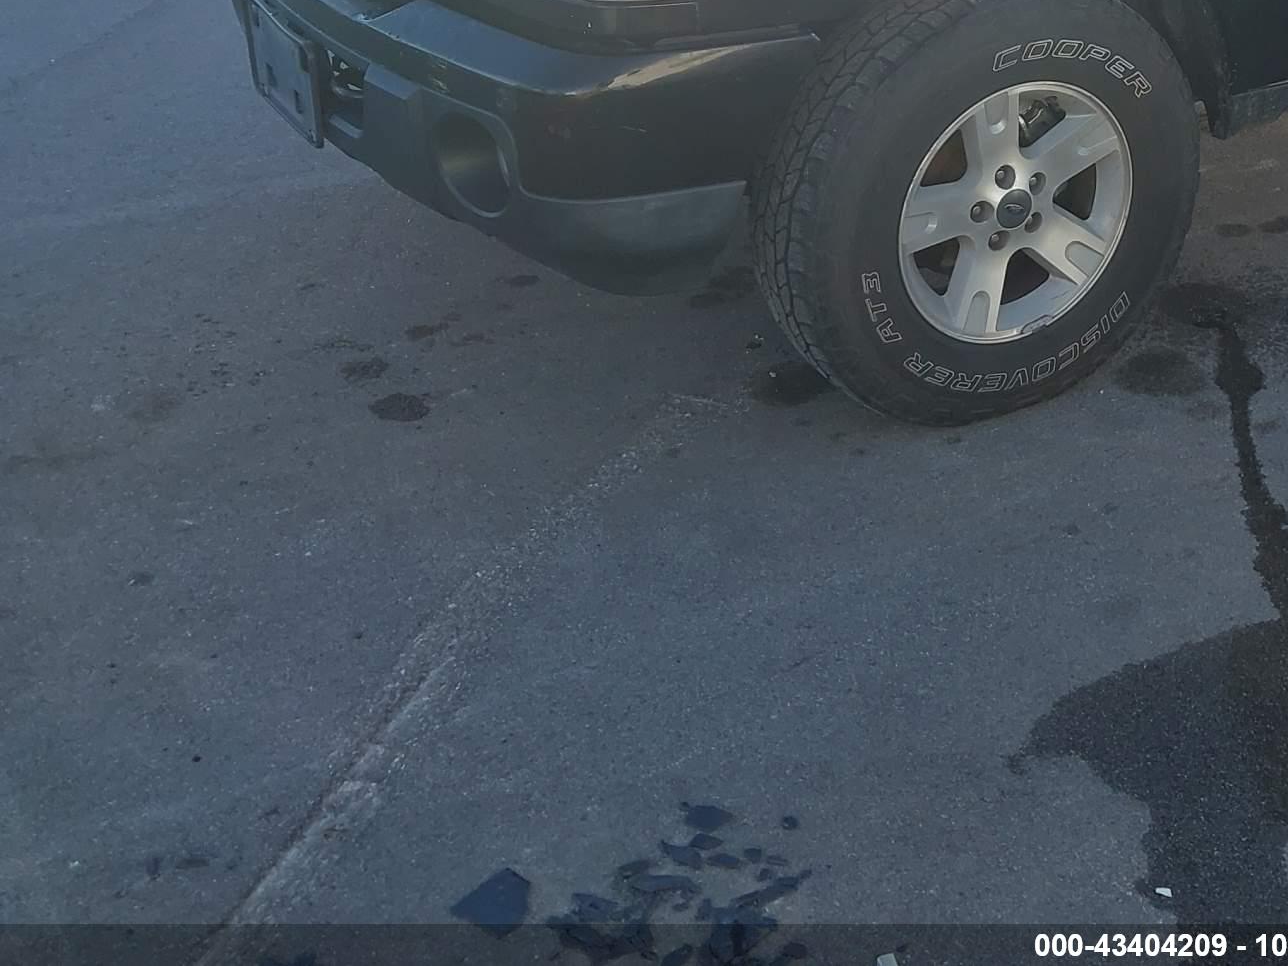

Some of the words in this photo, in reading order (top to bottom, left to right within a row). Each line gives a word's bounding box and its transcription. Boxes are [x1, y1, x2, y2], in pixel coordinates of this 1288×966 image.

[992, 39, 1152, 98] COOPER
[861, 271, 903, 344] AT3
[904, 291, 1130, 393] DISCOVERER
